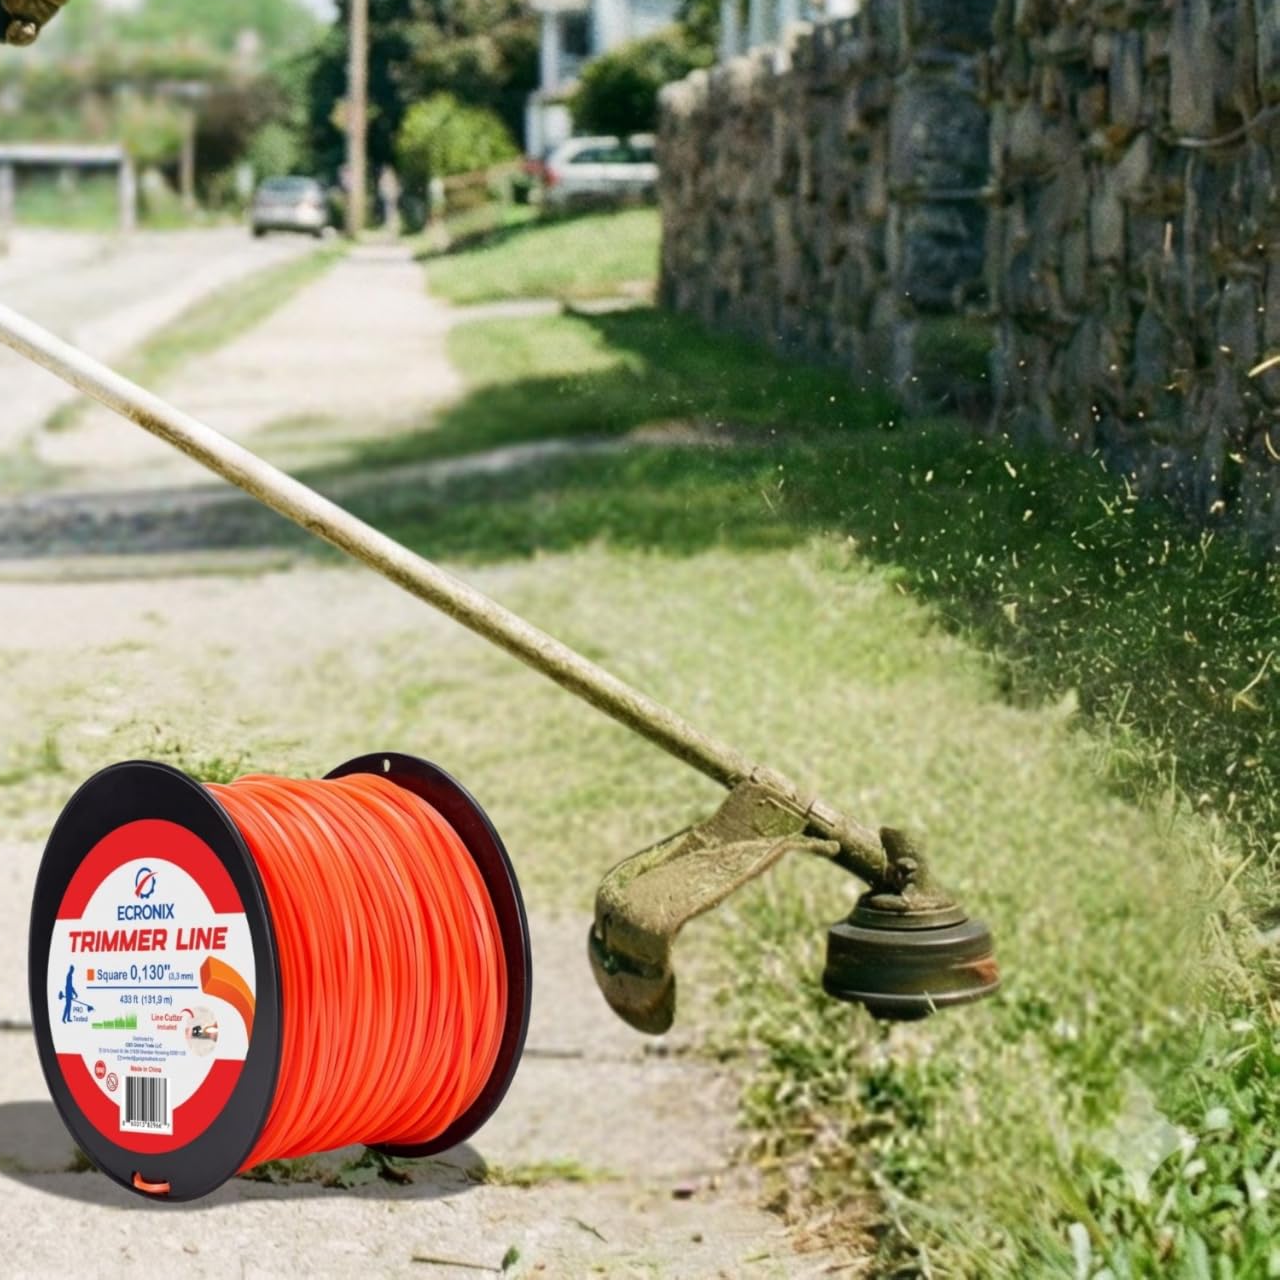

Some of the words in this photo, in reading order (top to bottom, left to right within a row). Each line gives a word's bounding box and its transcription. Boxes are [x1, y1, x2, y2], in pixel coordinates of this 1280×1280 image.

[118, 903, 174, 921] ECRONIX
[69, 929, 167, 952] TRIMMER
[176, 927, 228, 951] LINE
[97, 969, 127, 983] Square
[120, 995, 132, 1004] 433
